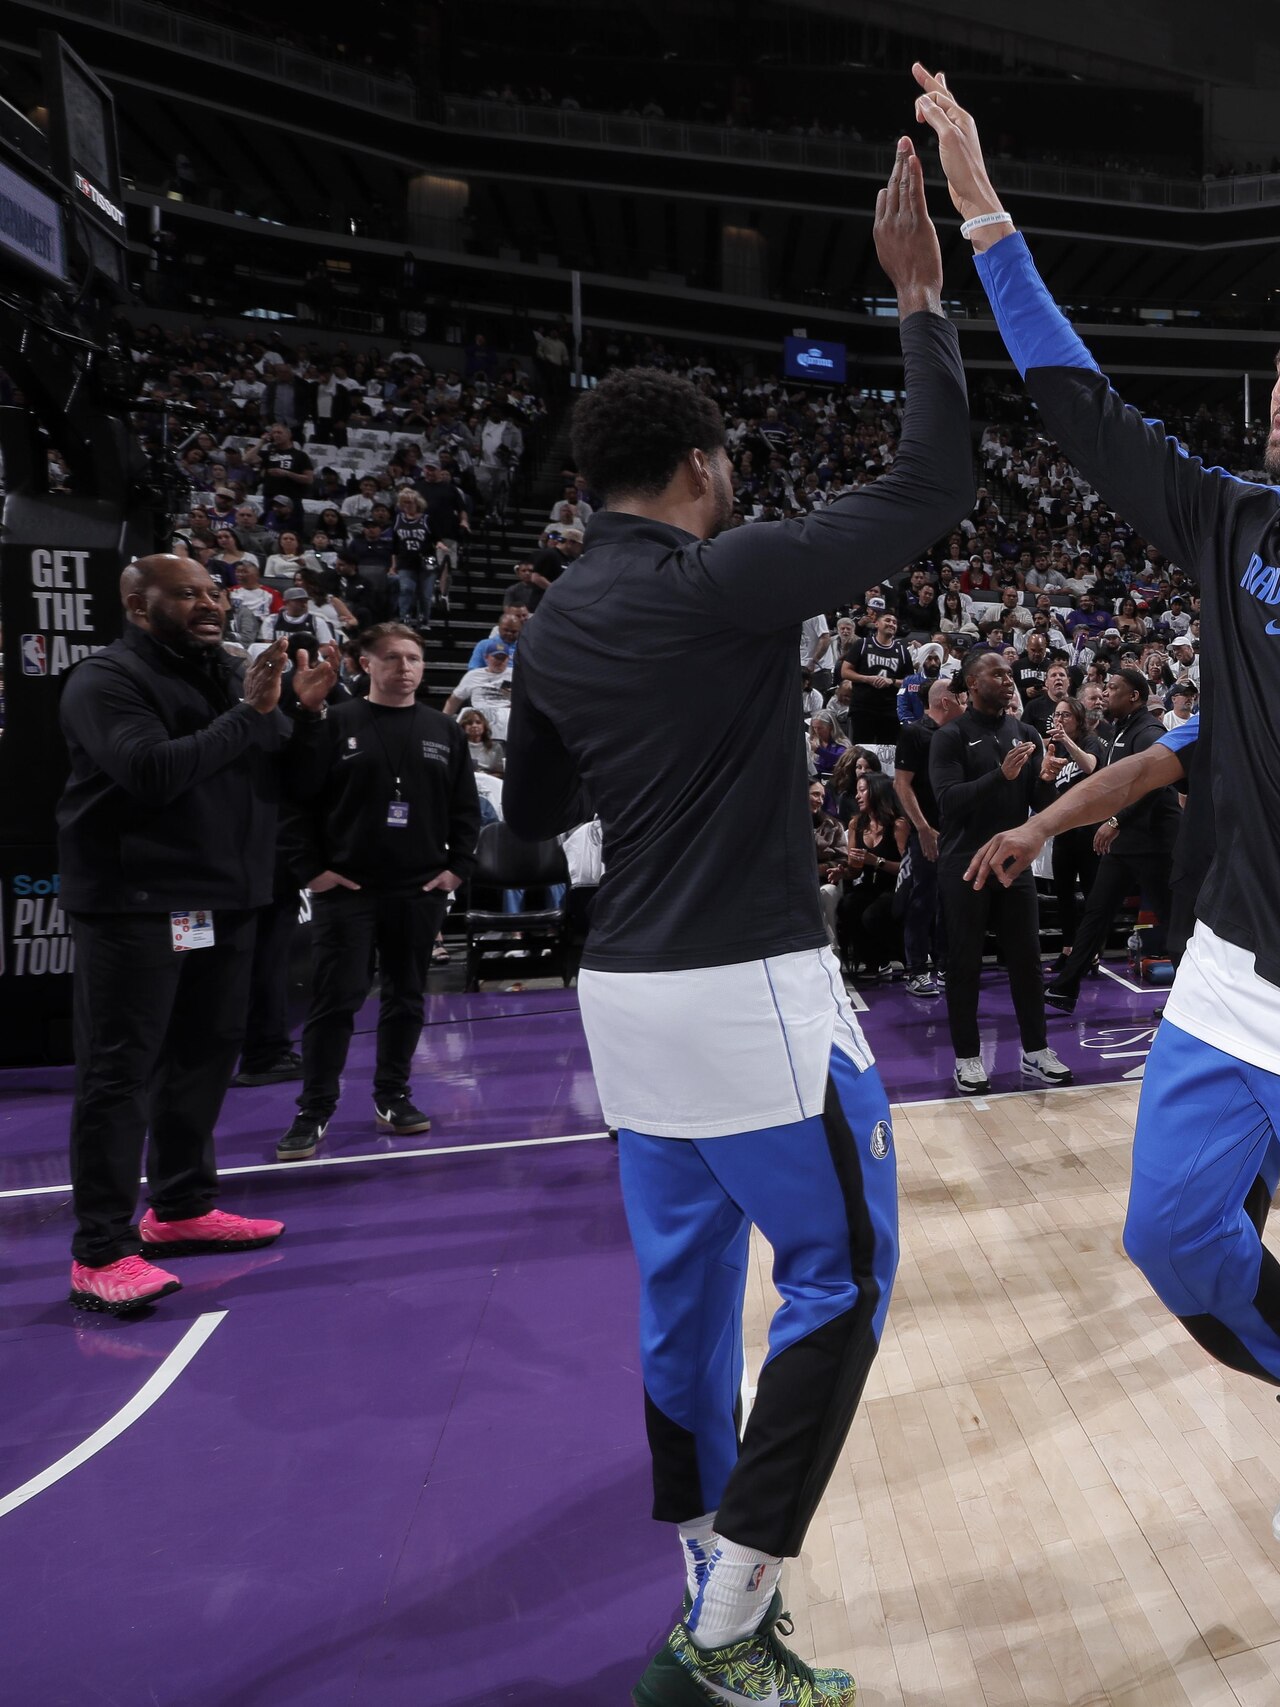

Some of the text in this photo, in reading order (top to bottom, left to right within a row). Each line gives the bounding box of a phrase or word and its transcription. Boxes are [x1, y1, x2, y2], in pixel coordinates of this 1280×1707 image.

[90, 183, 125, 226] TISSOT
[31, 548, 91, 589] GET
[32, 591, 95, 632] THE
[867, 653, 900, 673] KINGS
[14, 898, 72, 936] PLA
